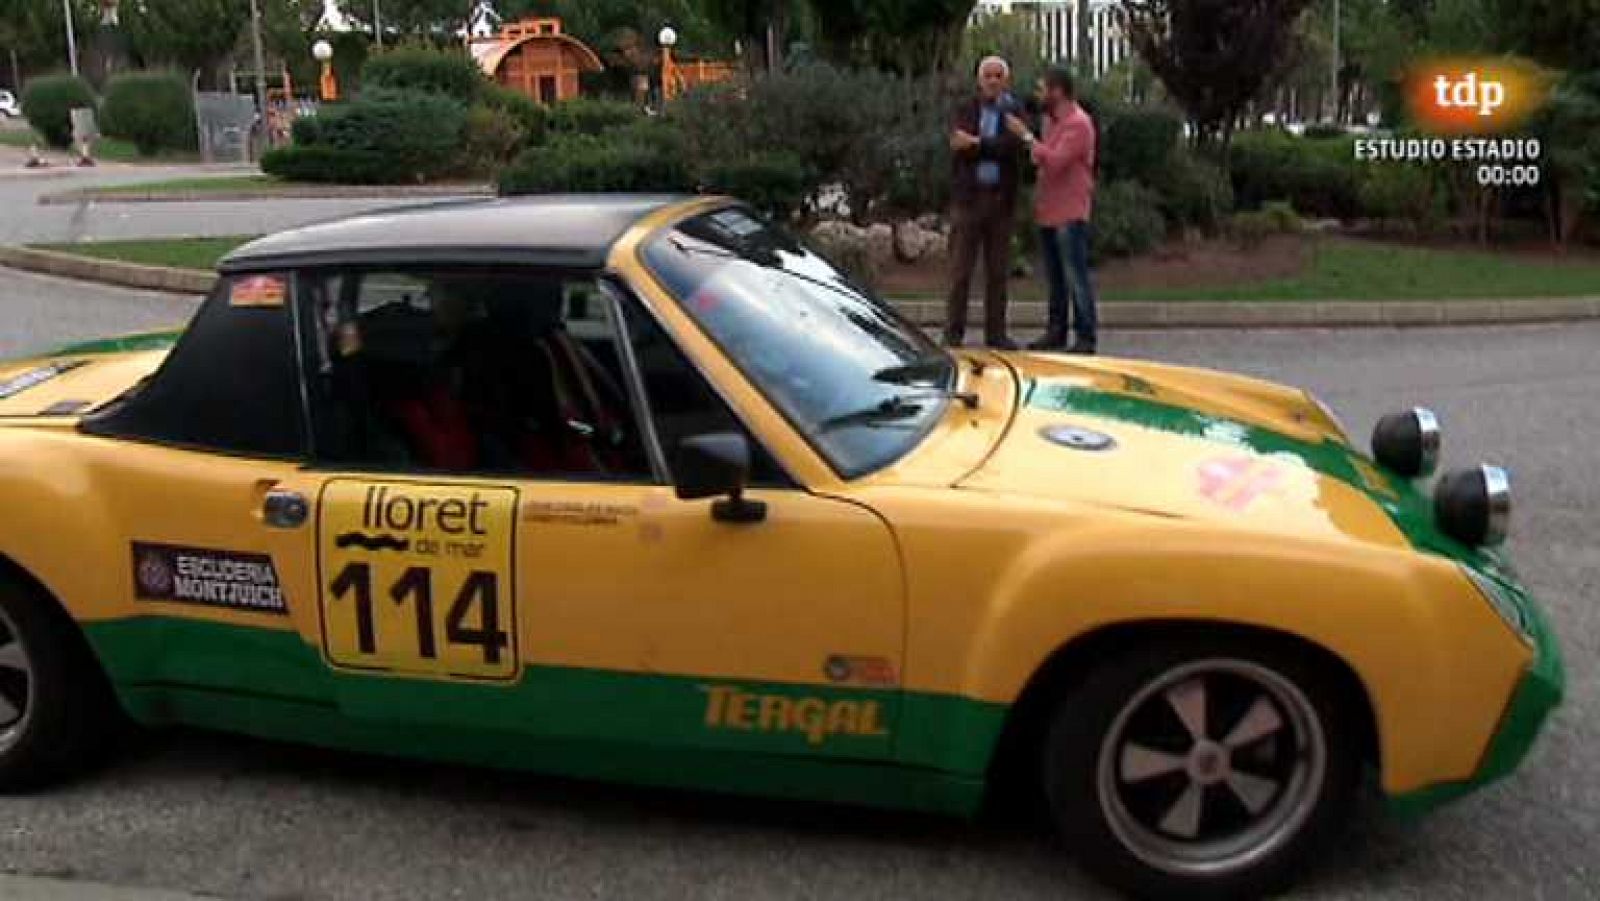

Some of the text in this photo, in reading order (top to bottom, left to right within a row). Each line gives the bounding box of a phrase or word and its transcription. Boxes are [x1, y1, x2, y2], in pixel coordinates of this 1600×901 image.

[363, 486, 488, 535] lloret
[415, 539, 485, 558] de mar
[176, 555, 274, 585] ESCUDERIA
[174, 575, 284, 608] MONTJUICH
[330, 561, 508, 664] 114
